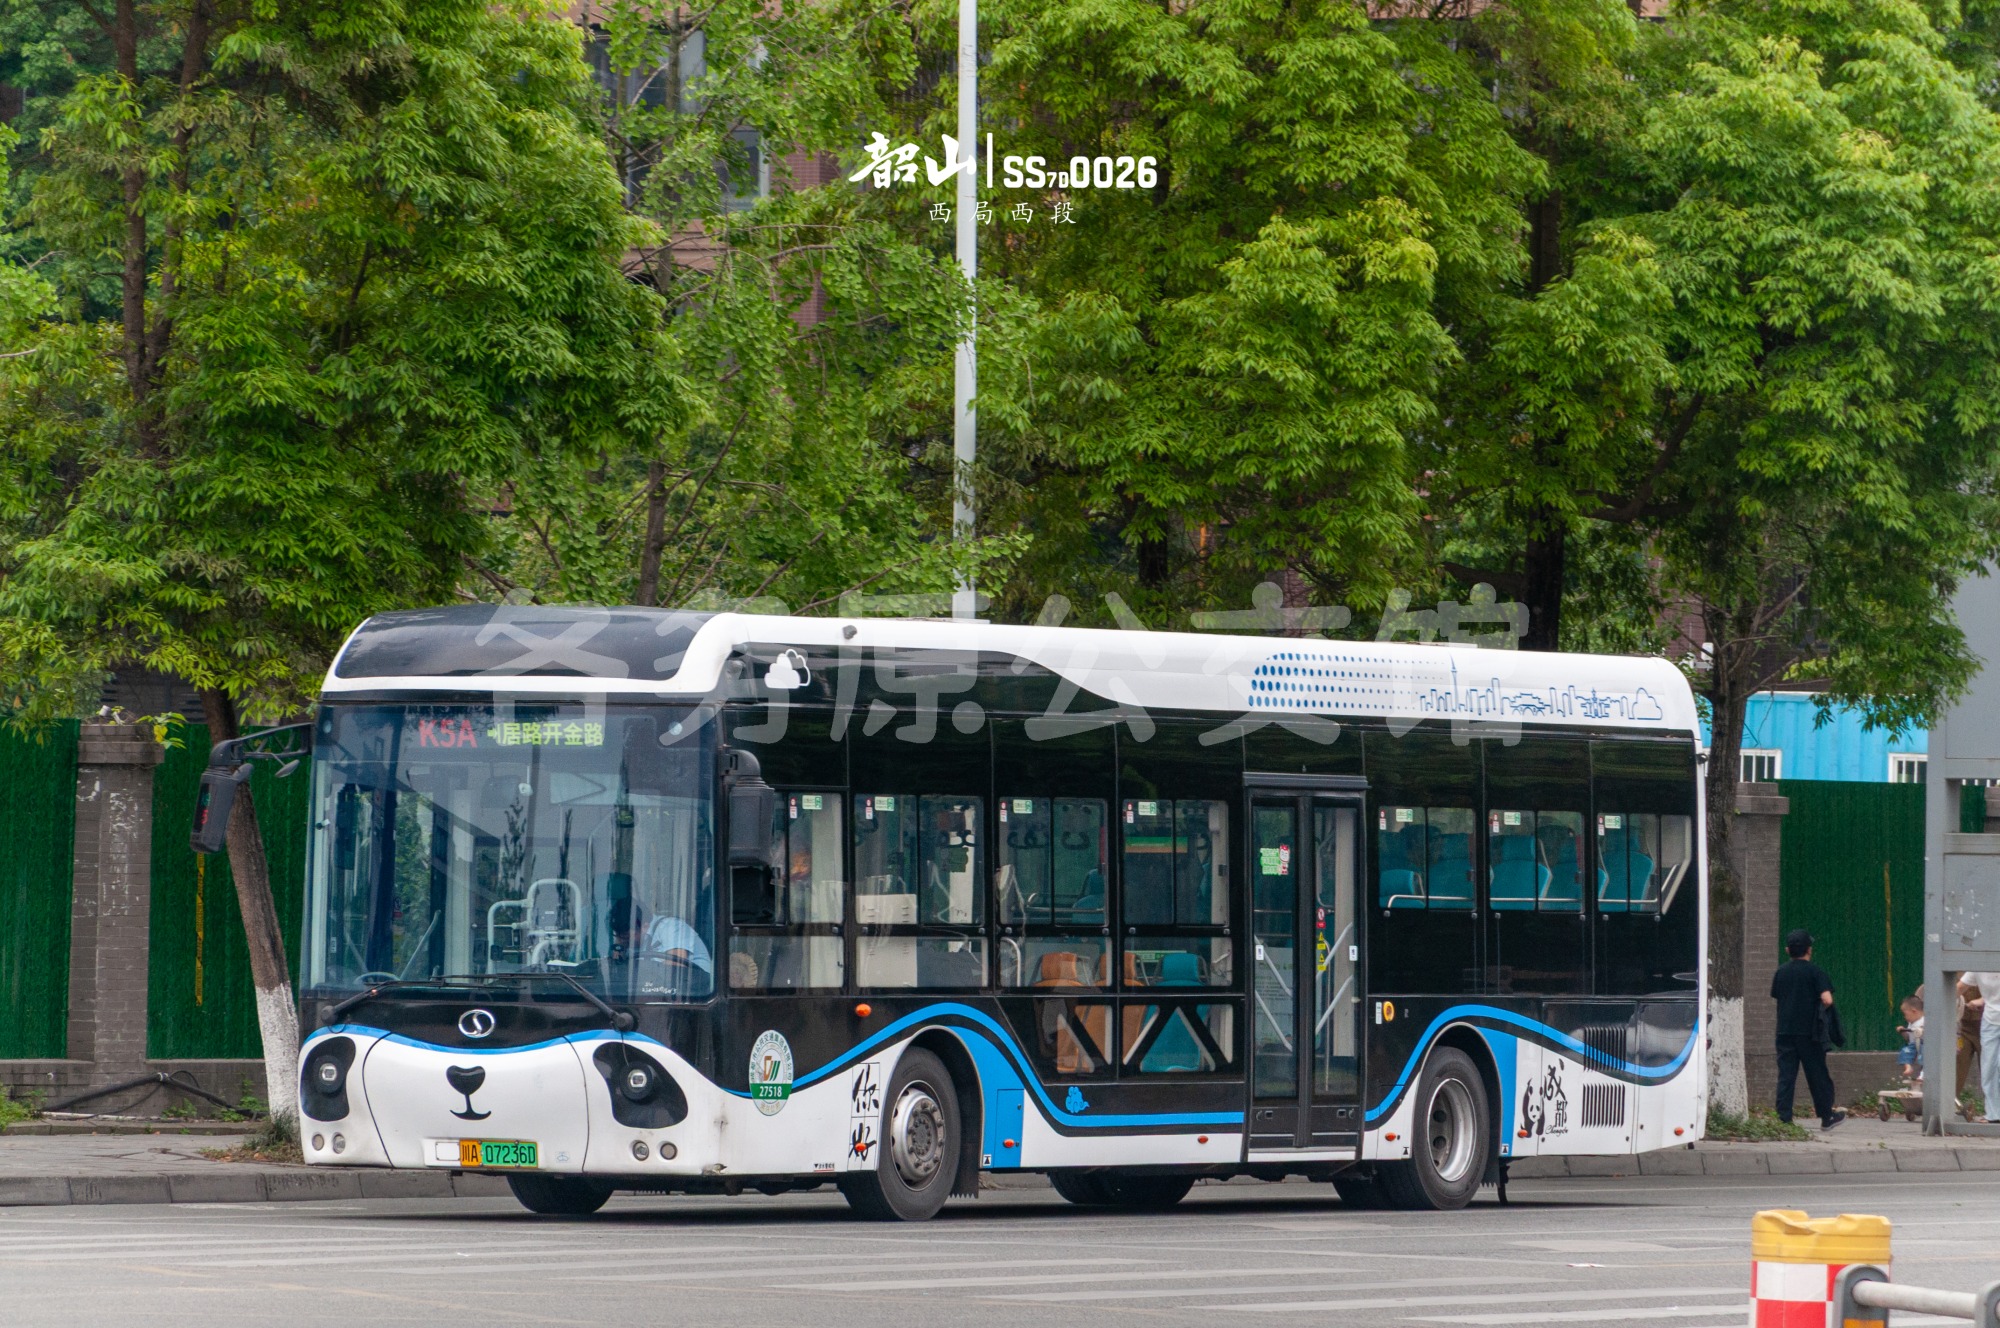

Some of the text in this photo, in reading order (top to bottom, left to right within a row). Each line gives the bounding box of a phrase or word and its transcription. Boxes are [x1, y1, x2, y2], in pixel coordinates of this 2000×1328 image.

[418, 719, 478, 748] K5A
[759, 1086, 783, 1098] 27518
[1543, 1058, 1569, 1128] 成都
